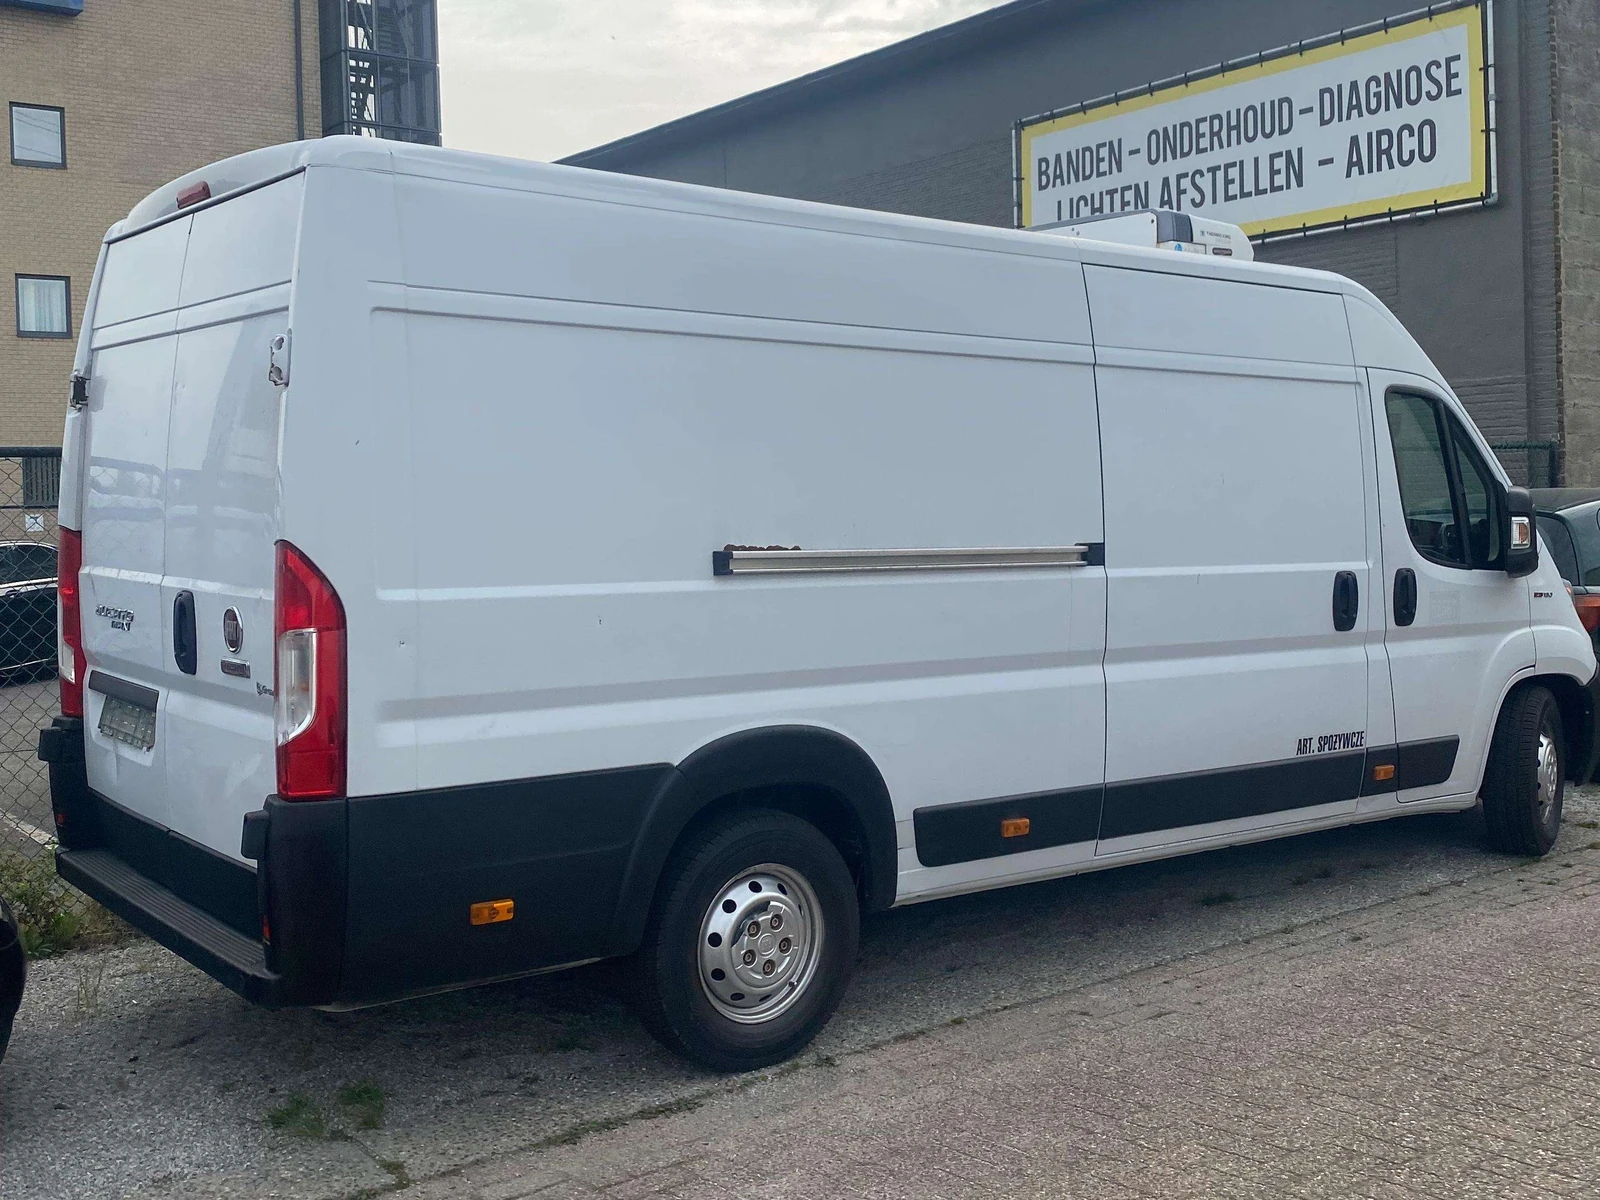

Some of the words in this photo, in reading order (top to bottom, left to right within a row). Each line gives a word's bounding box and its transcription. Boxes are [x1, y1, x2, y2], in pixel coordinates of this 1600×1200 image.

[1037, 138, 1122, 191] BANDEN
[1146, 96, 1293, 166] ONDERHOUD
[1318, 54, 1462, 127] DIAGNOSE
[1159, 146, 1303, 211] AFSTELLEN
[1345, 118, 1437, 179] AIRCO
[1296, 737, 1315, 756] ART.
